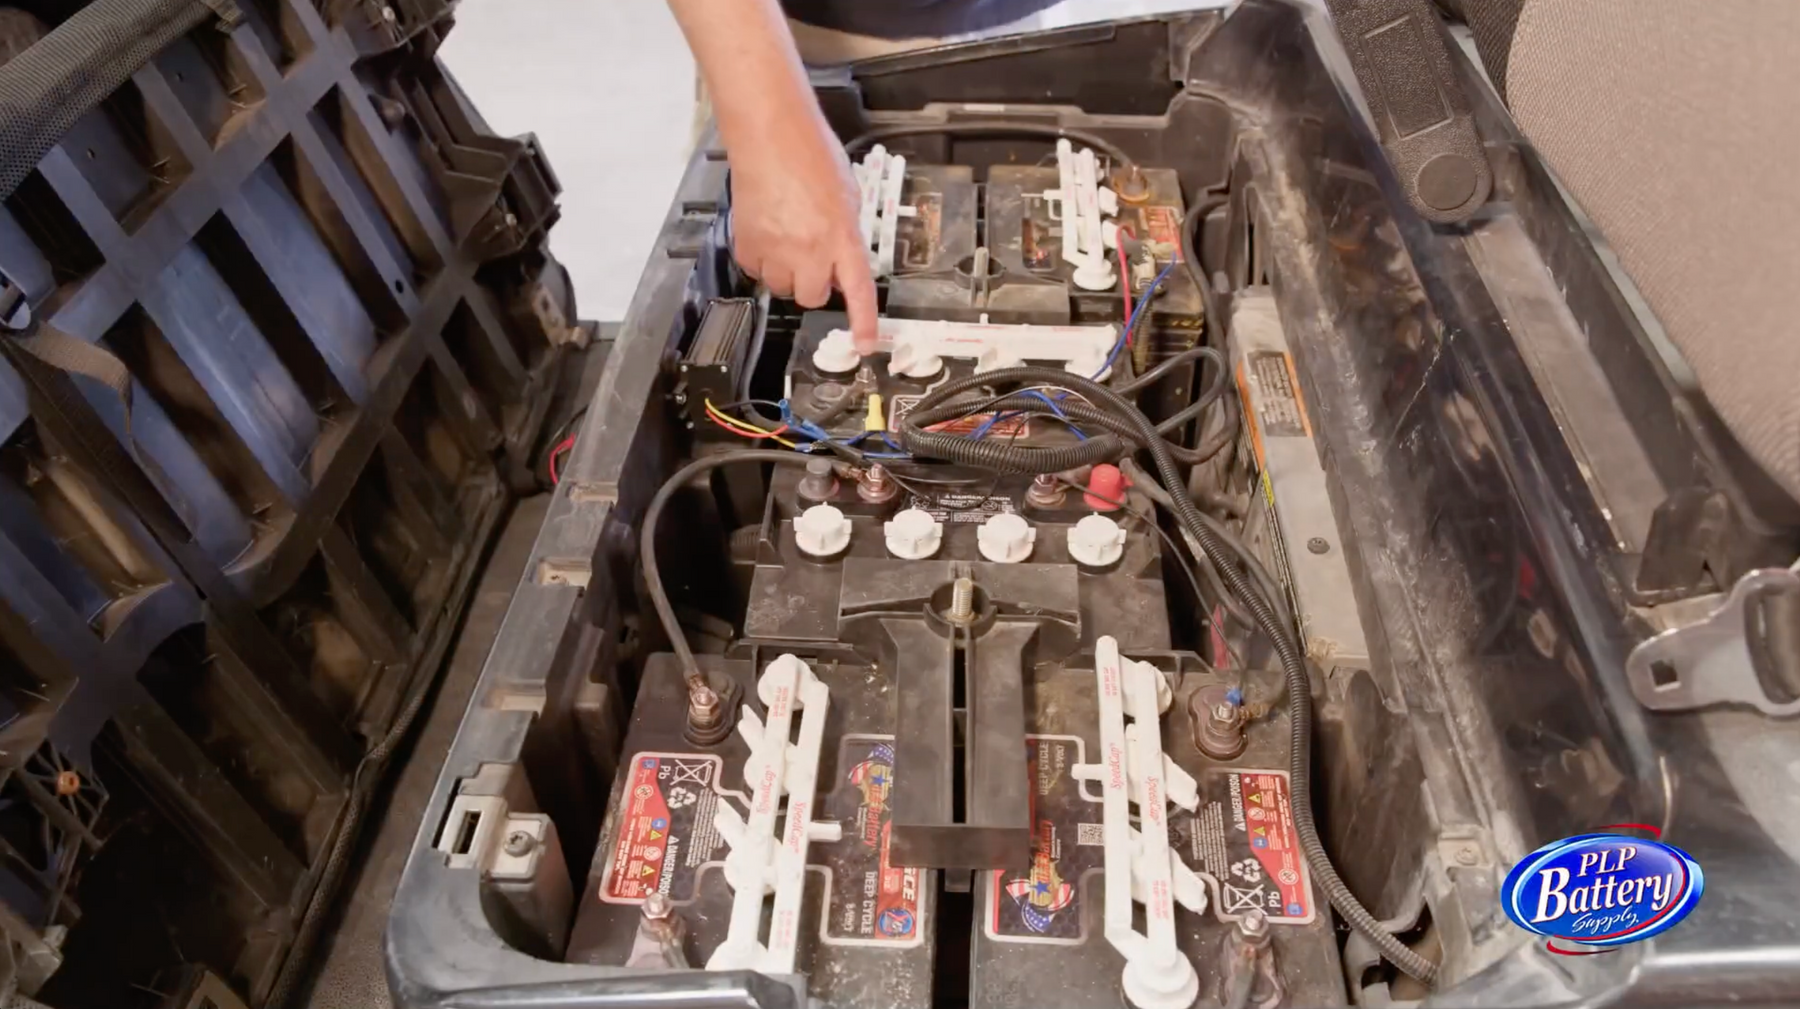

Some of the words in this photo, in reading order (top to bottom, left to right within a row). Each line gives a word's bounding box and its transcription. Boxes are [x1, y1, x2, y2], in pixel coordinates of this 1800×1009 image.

[658, 765, 671, 780] Pb
[658, 845, 678, 897] DANGER/POISO
[864, 872, 877, 897] DEEP
[1268, 891, 1281, 907] Pb
[861, 900, 874, 934] CYCLE
